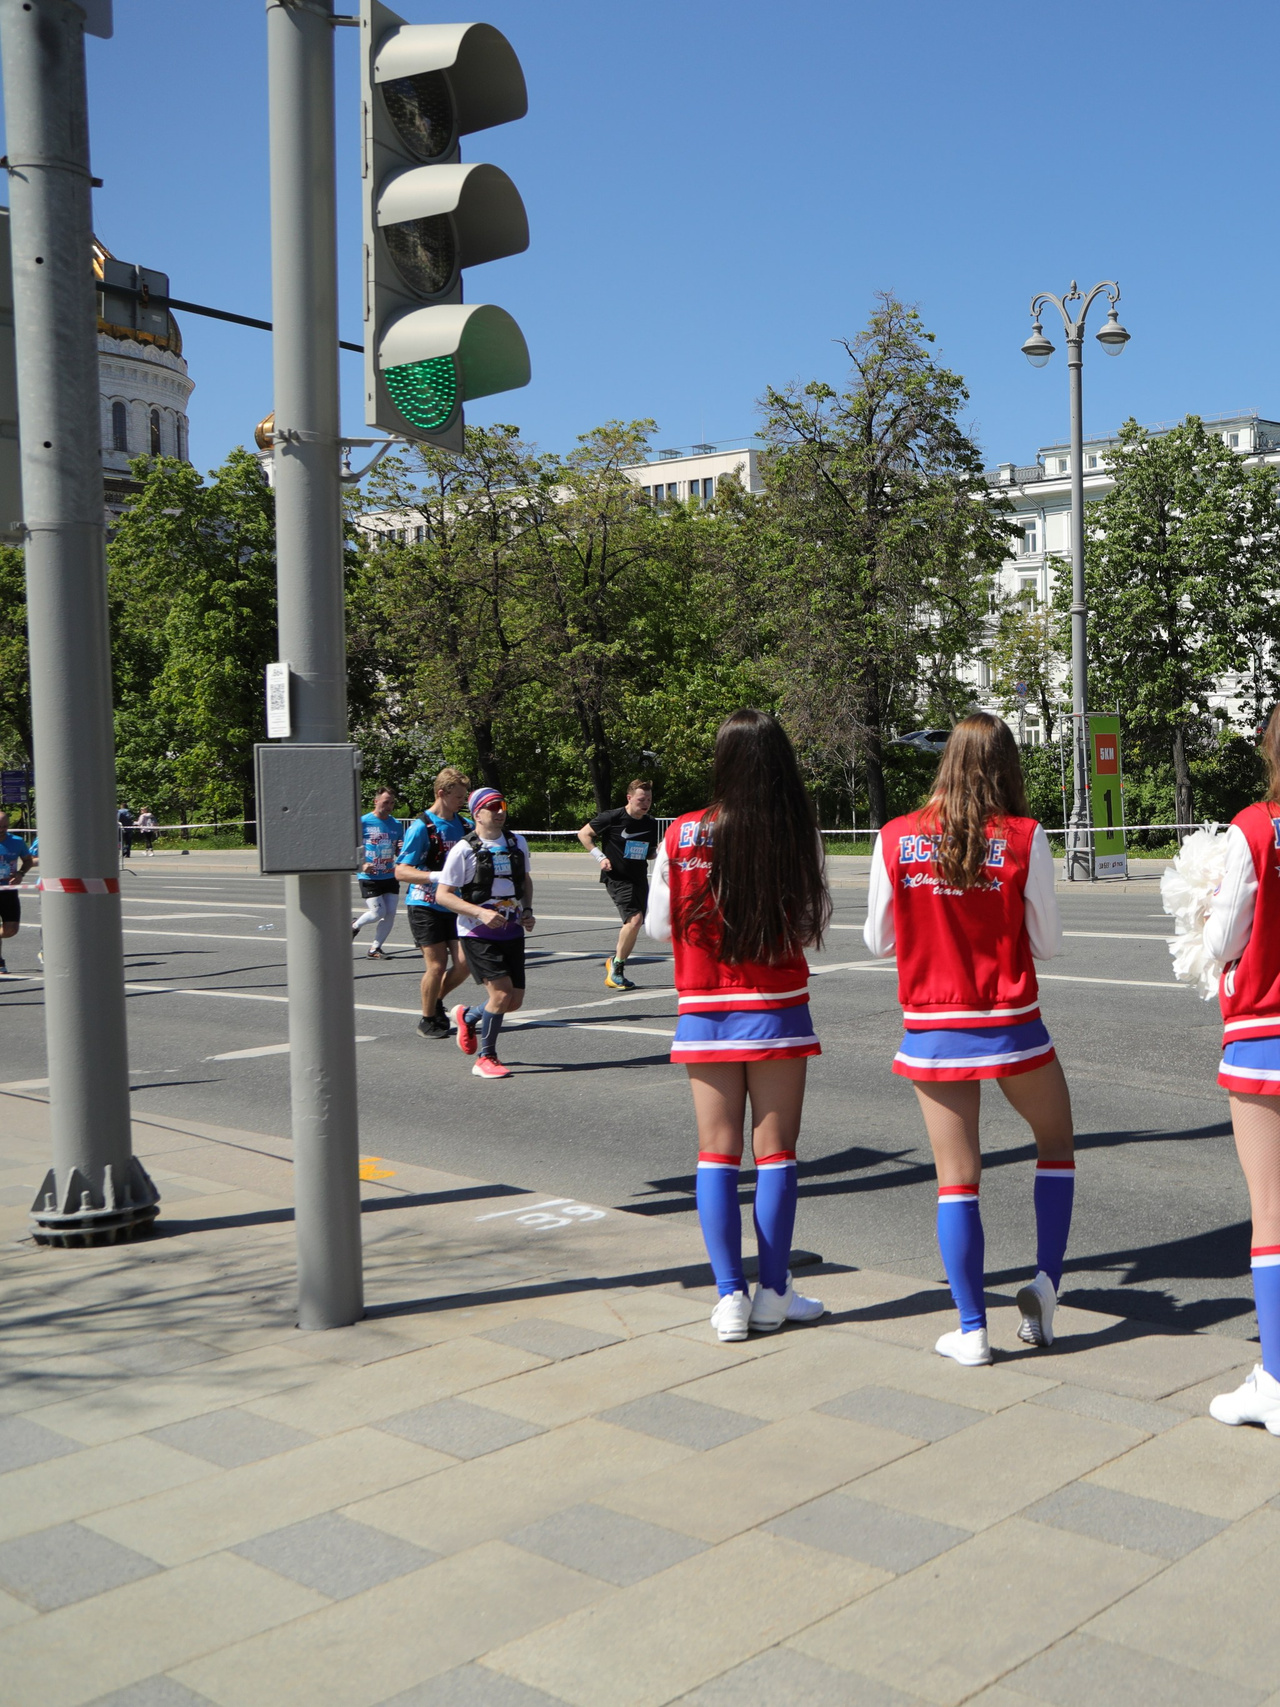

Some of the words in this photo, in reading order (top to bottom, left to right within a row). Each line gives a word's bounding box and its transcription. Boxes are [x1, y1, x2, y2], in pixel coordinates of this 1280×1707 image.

[1099, 747, 1115, 761] 5KM
[1103, 789, 1113, 828] 1
[932, 885, 964, 896] team
